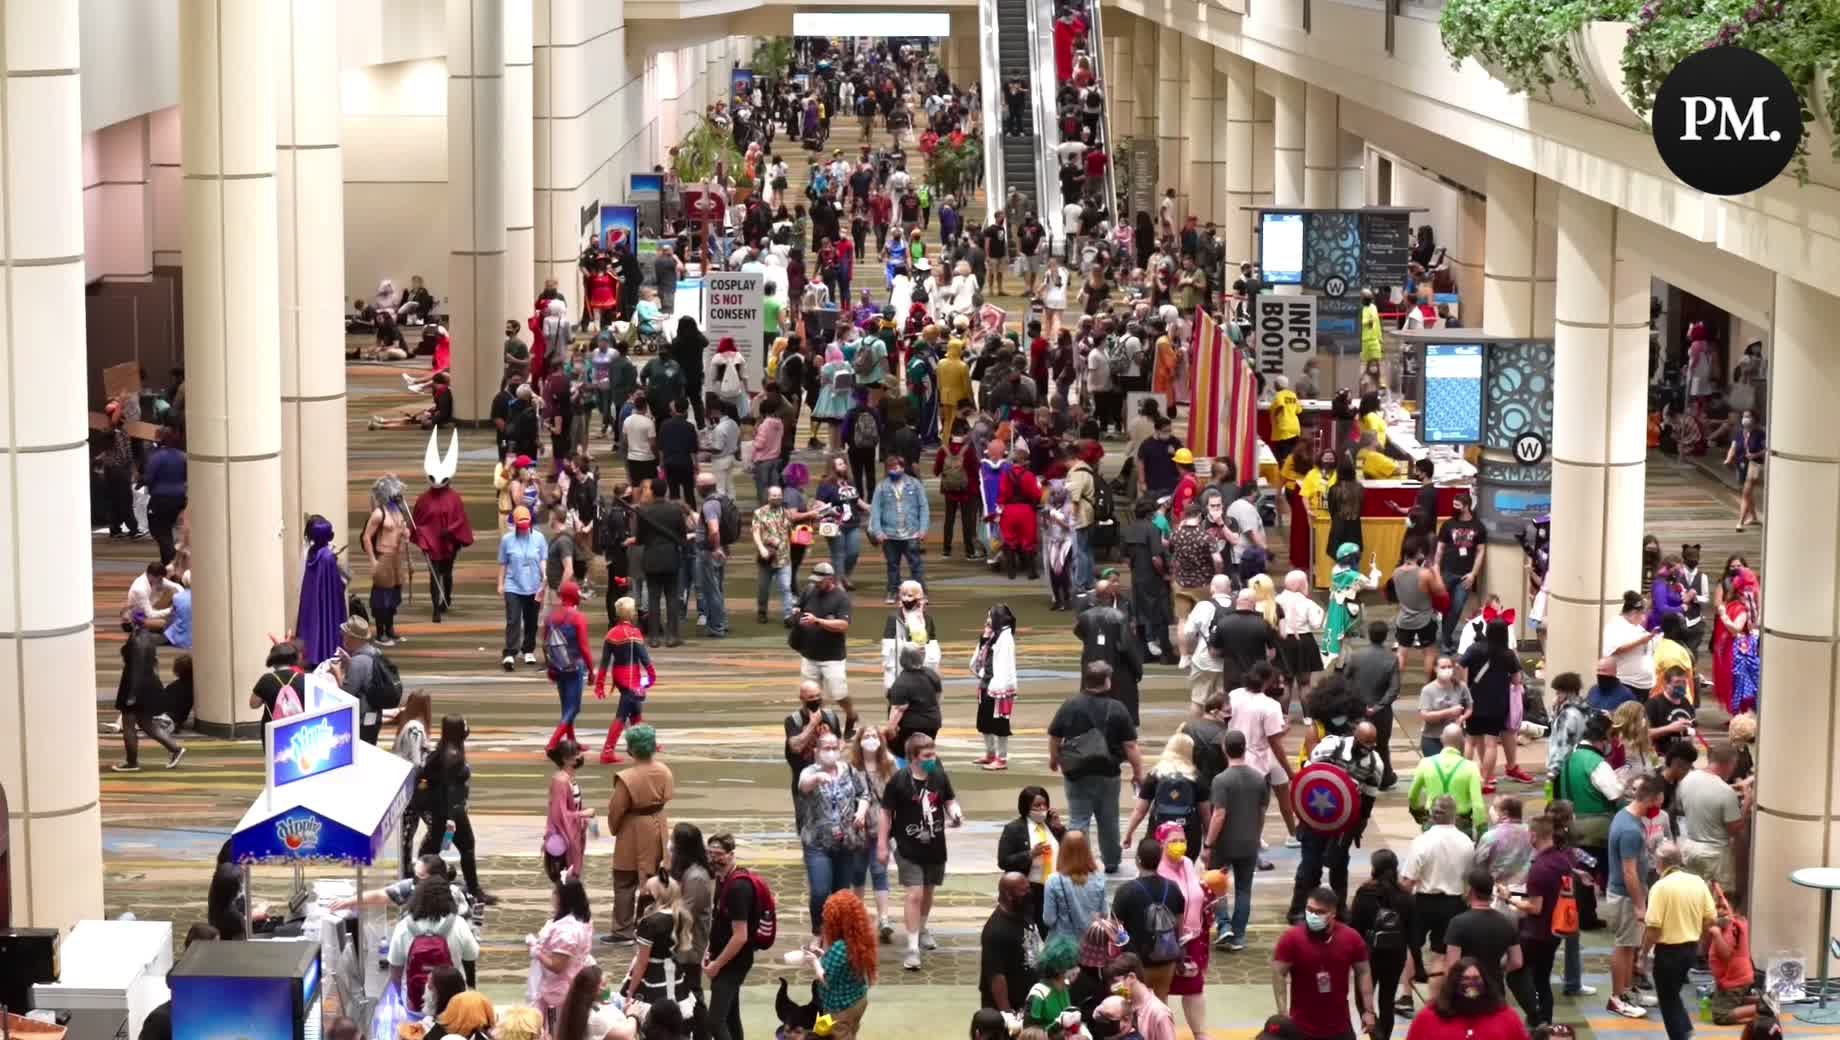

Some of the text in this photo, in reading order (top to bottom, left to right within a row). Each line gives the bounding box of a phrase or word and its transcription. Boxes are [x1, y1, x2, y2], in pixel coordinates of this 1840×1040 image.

[710, 280, 756, 291] COSPLAY
[1329, 282, 1344, 293] W
[710, 294, 744, 305] IS NOT
[710, 308, 757, 320] CONSENT
[1288, 303, 1311, 353] INFO
[1261, 303, 1284, 374] BOOTH
[1520, 442, 1539, 458] W
